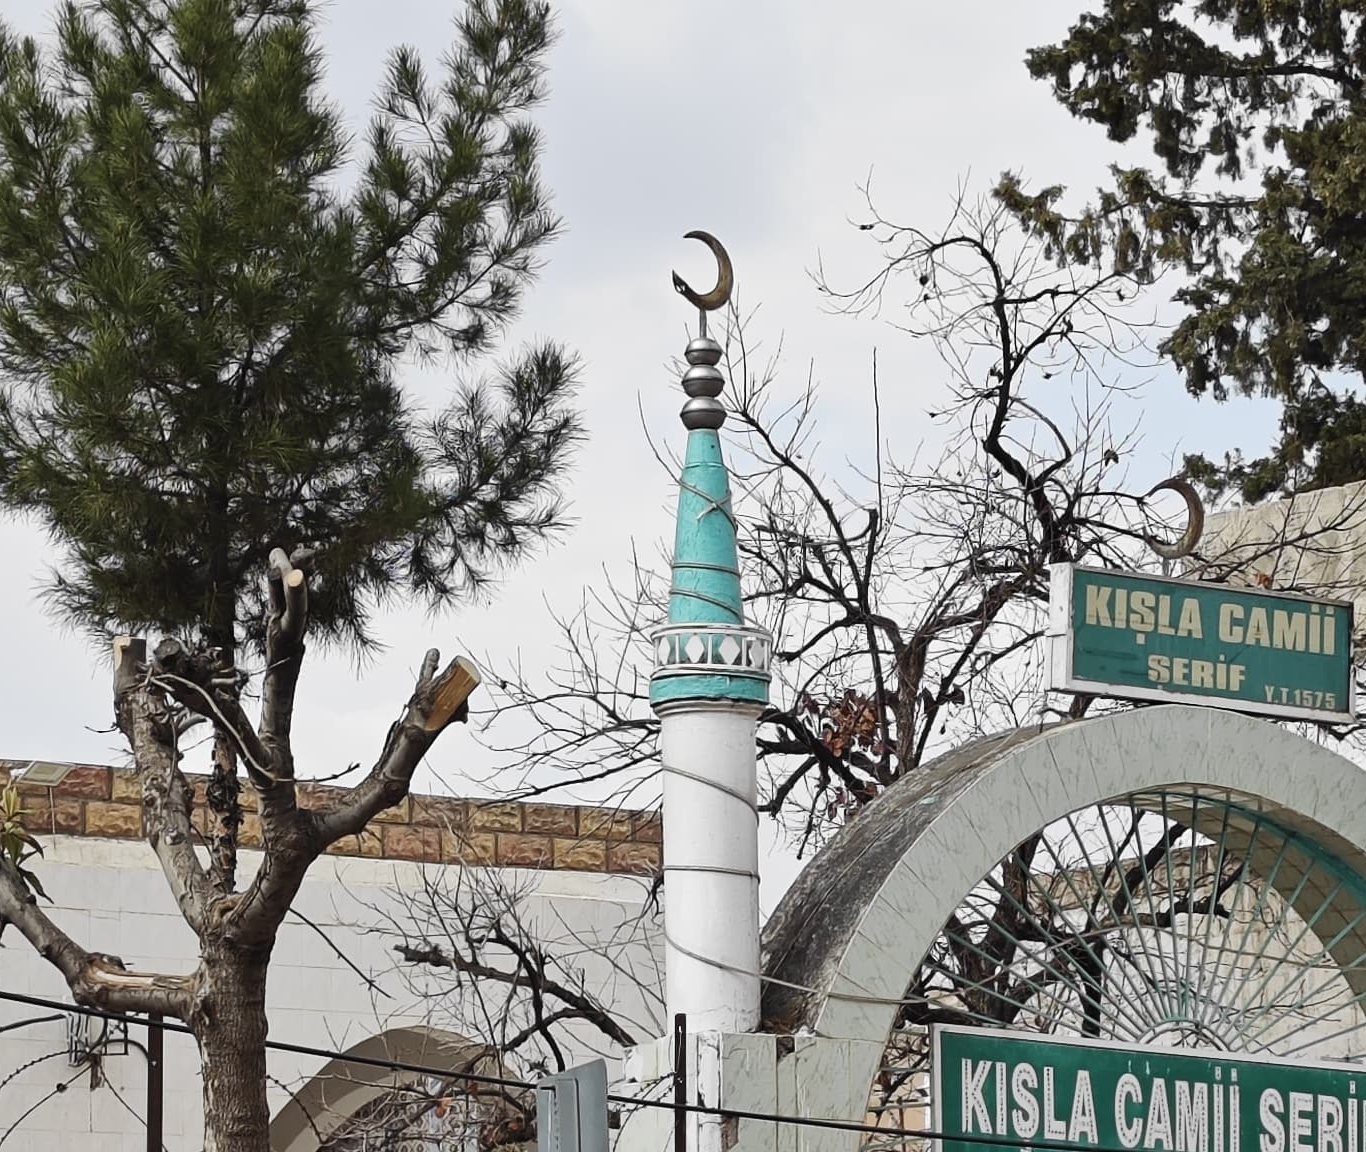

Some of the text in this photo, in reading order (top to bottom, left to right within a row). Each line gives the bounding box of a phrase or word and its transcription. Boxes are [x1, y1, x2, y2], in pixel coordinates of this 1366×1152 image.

[1086, 584, 1335, 656] KIŞLA CAMİİ
[1148, 654, 1246, 691] ŞERİF
